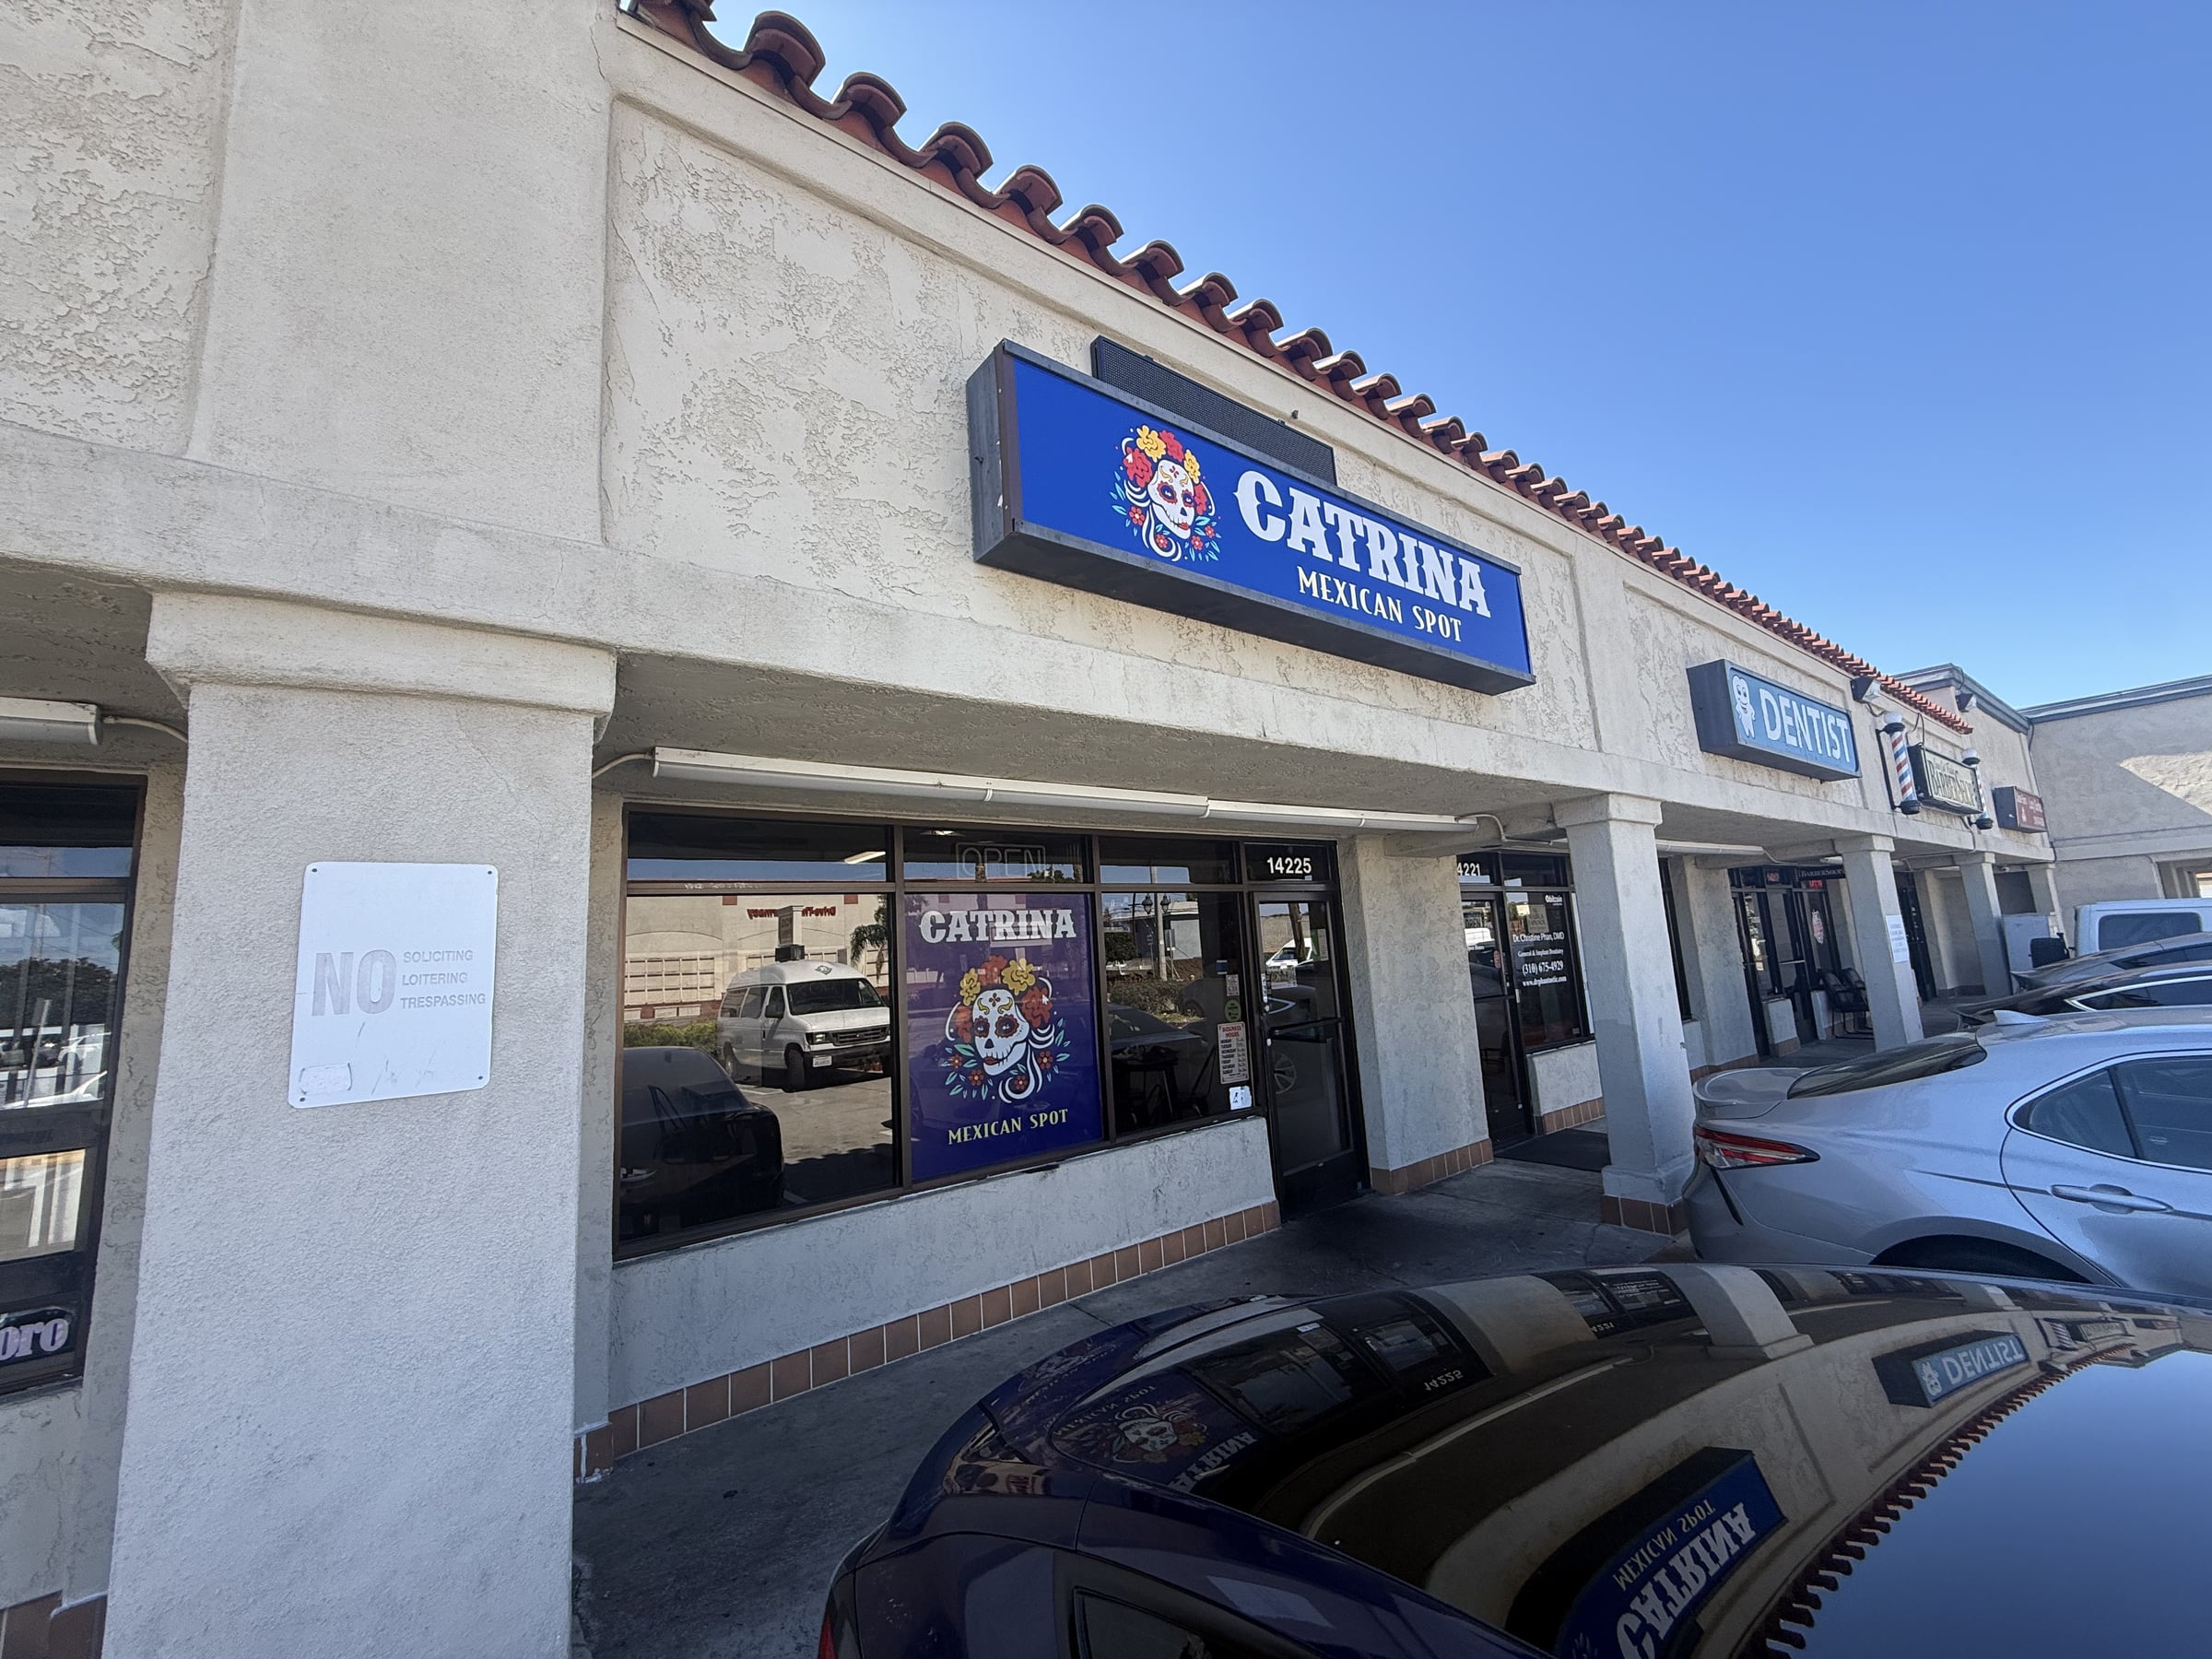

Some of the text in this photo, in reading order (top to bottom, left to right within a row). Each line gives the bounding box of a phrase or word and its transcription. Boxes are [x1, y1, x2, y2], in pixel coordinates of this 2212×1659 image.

[1233, 470, 1491, 618] CATRINA
[1296, 565, 1462, 642] MEXICAN SPOT
[1759, 688, 1851, 763] DENTIST
[961, 847, 1041, 877] OPEN
[1266, 856, 1312, 875] 14225
[1456, 862, 1481, 877] 4221
[919, 909, 1077, 944] CATRINA
[403, 949, 474, 963] SOLICITING
[312, 949, 397, 1017] NO
[402, 972, 468, 986] LOITERING
[400, 993, 487, 1009] TRESPASSING
[947, 1108, 1068, 1146] MEXICAN SPOT
